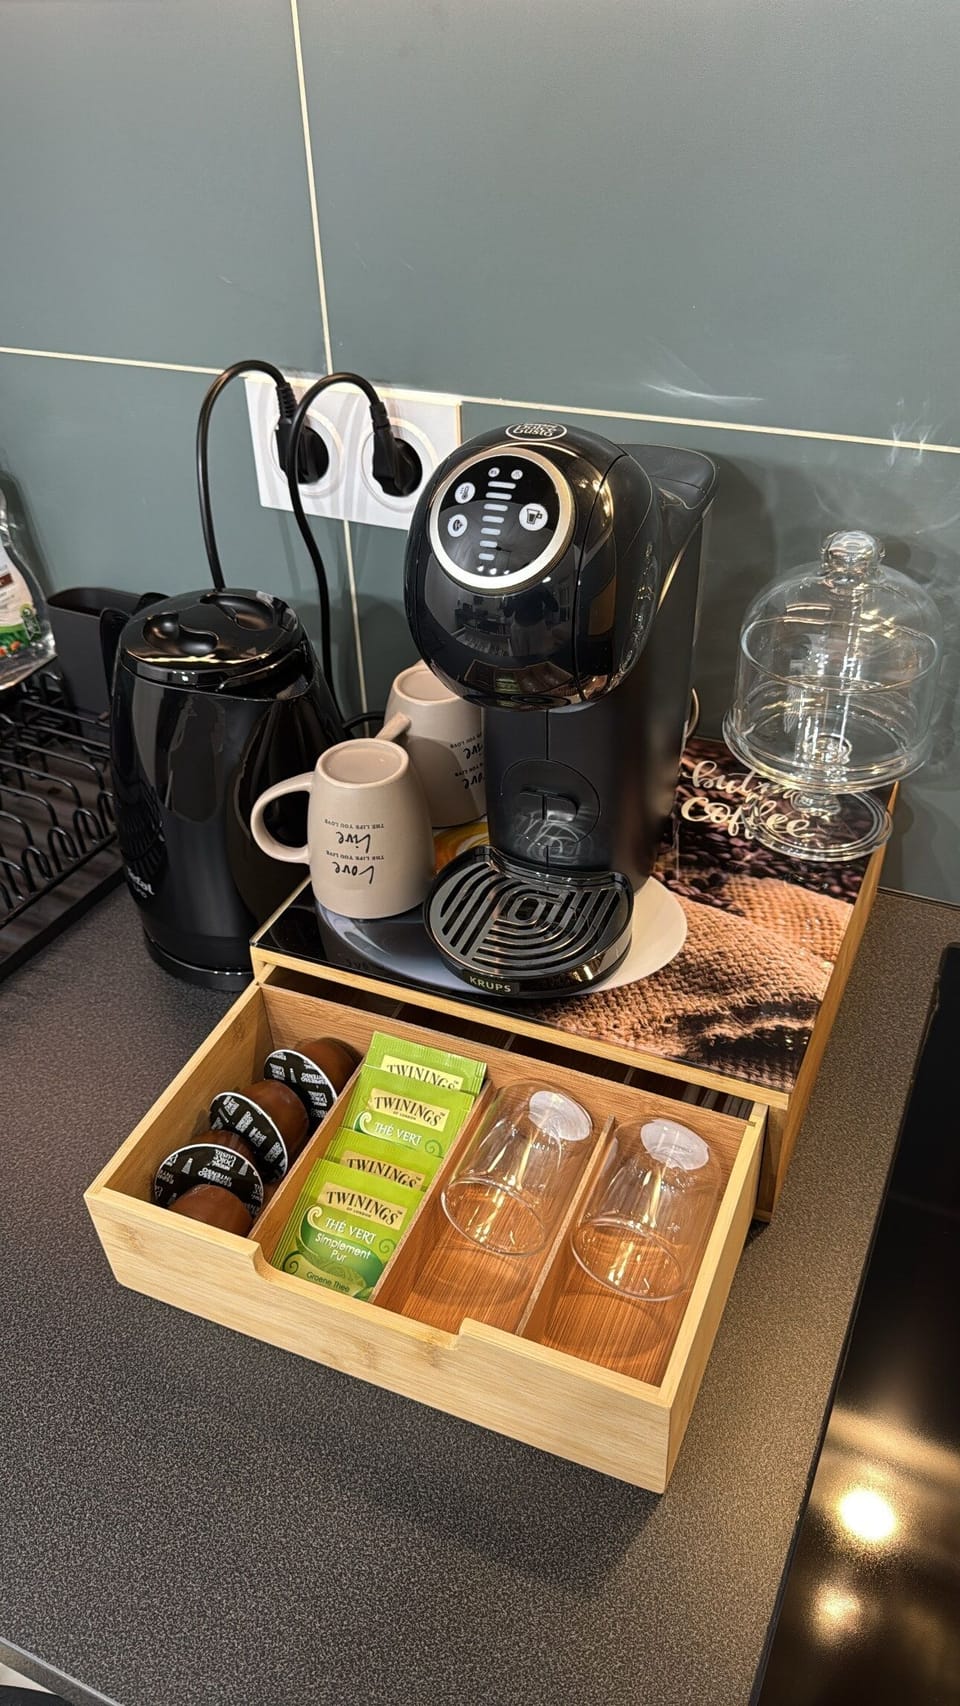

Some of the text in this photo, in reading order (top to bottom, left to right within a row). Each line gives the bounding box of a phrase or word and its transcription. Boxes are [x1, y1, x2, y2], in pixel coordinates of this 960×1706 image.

[462, 772, 483, 789] ove
[335, 831, 371, 854] Live
[332, 861, 374, 885] Love
[470, 976, 511, 992] KRUPS
[374, 1096, 442, 1127] TWININGS
[374, 1122, 423, 1146] THÉ VERT
[346, 1158, 417, 1187] TWININGS
[326, 1191, 399, 1226] TWININGS
[325, 1217, 376, 1244] THÉ VERT
[315, 1232, 371, 1260] Simplement
[330, 1249, 347, 1262] Pur
[306, 1271, 332, 1286] Groene
